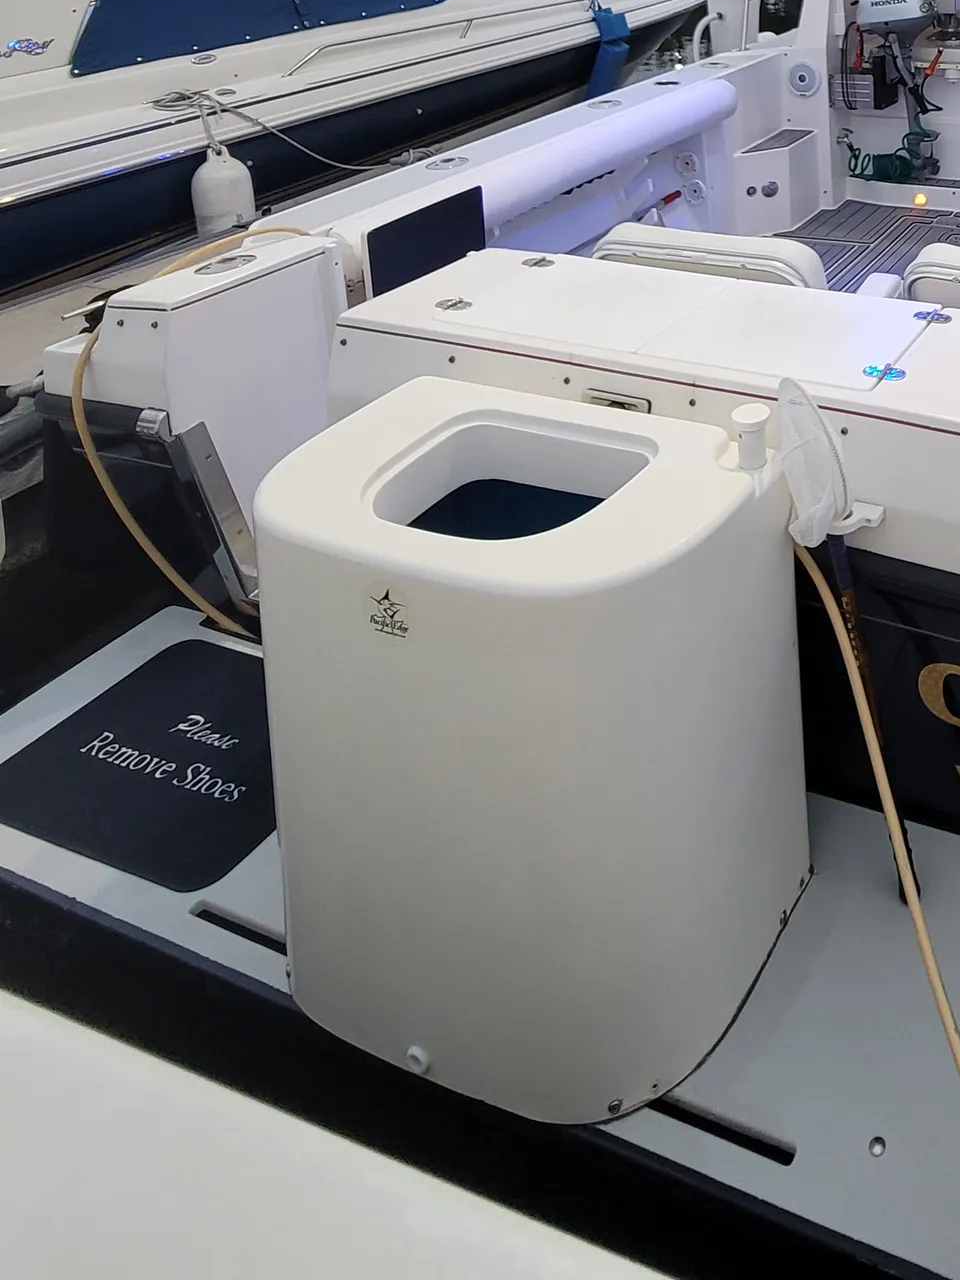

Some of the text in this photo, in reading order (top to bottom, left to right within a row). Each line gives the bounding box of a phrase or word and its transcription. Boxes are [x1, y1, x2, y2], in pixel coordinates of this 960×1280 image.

[168, 714, 240, 750] Please
[79, 731, 247, 803] Remove Shoes
